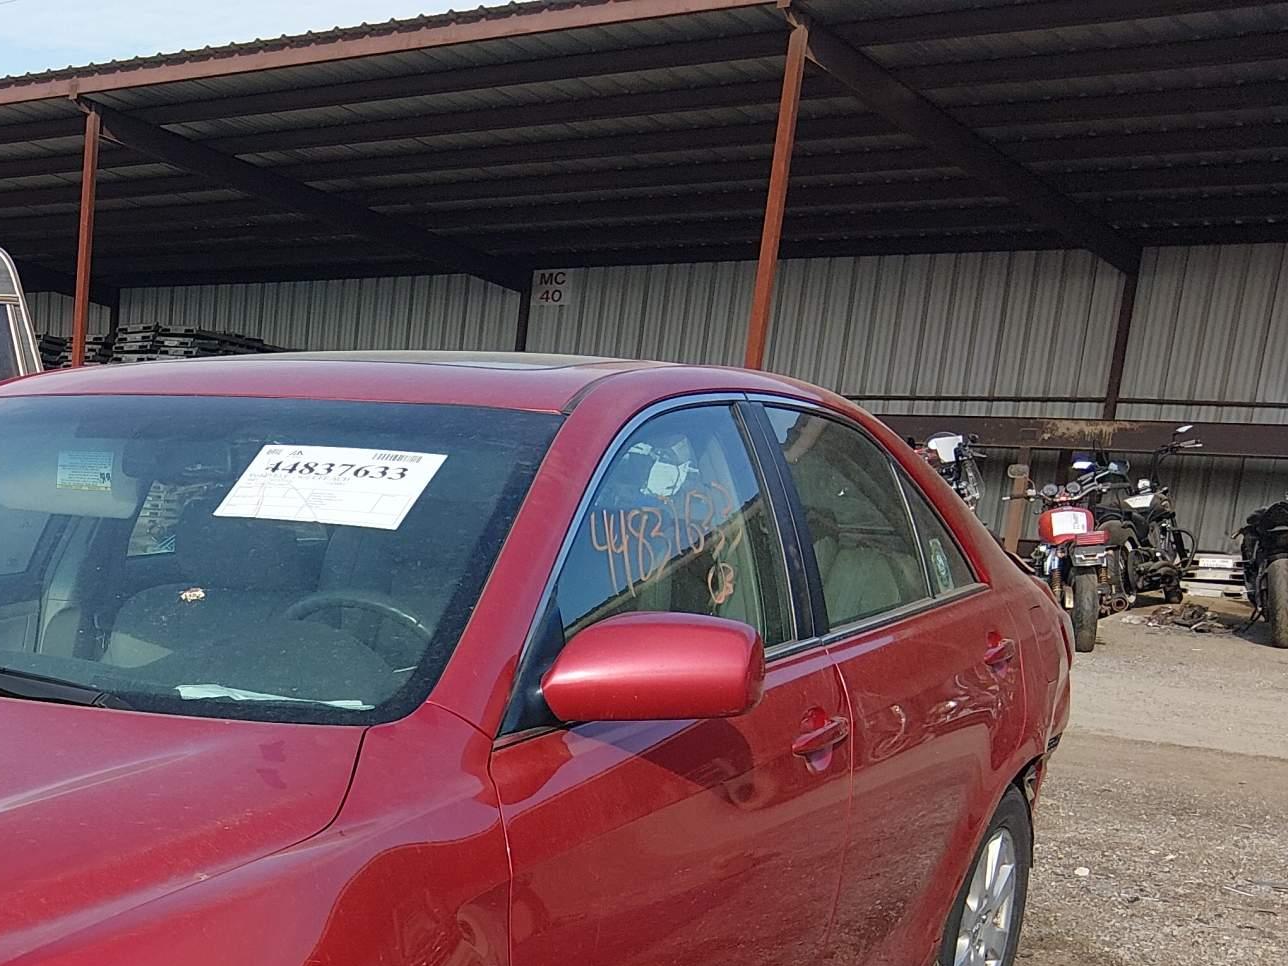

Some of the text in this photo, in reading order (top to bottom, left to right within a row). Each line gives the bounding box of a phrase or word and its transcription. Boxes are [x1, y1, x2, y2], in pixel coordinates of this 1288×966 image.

[539, 271, 566, 286] MC
[539, 289, 562, 303] 40
[265, 460, 409, 481] 44837633
